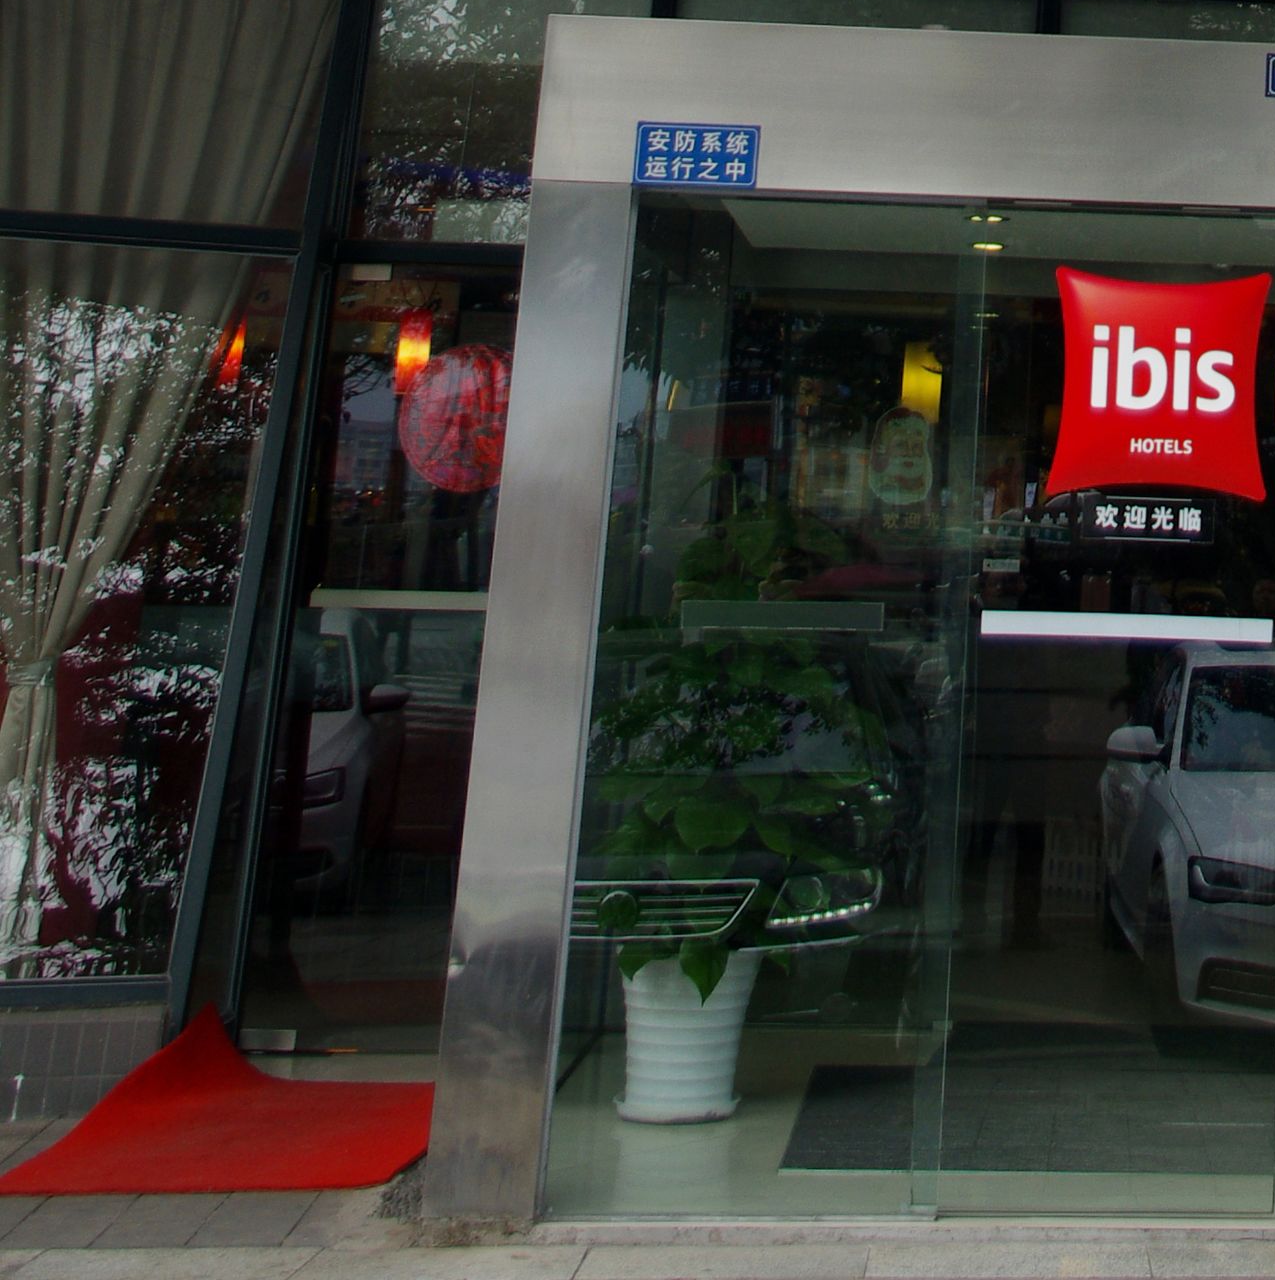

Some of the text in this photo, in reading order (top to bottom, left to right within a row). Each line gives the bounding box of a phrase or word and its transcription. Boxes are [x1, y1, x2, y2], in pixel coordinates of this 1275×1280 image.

[648, 129, 749, 155] 安防系统
[644, 156, 746, 181] 运行之中
[1090, 325, 1236, 412] ibis
[1129, 438, 1193, 455] HOTELS
[1095, 504, 1202, 532] 欢迎光临
